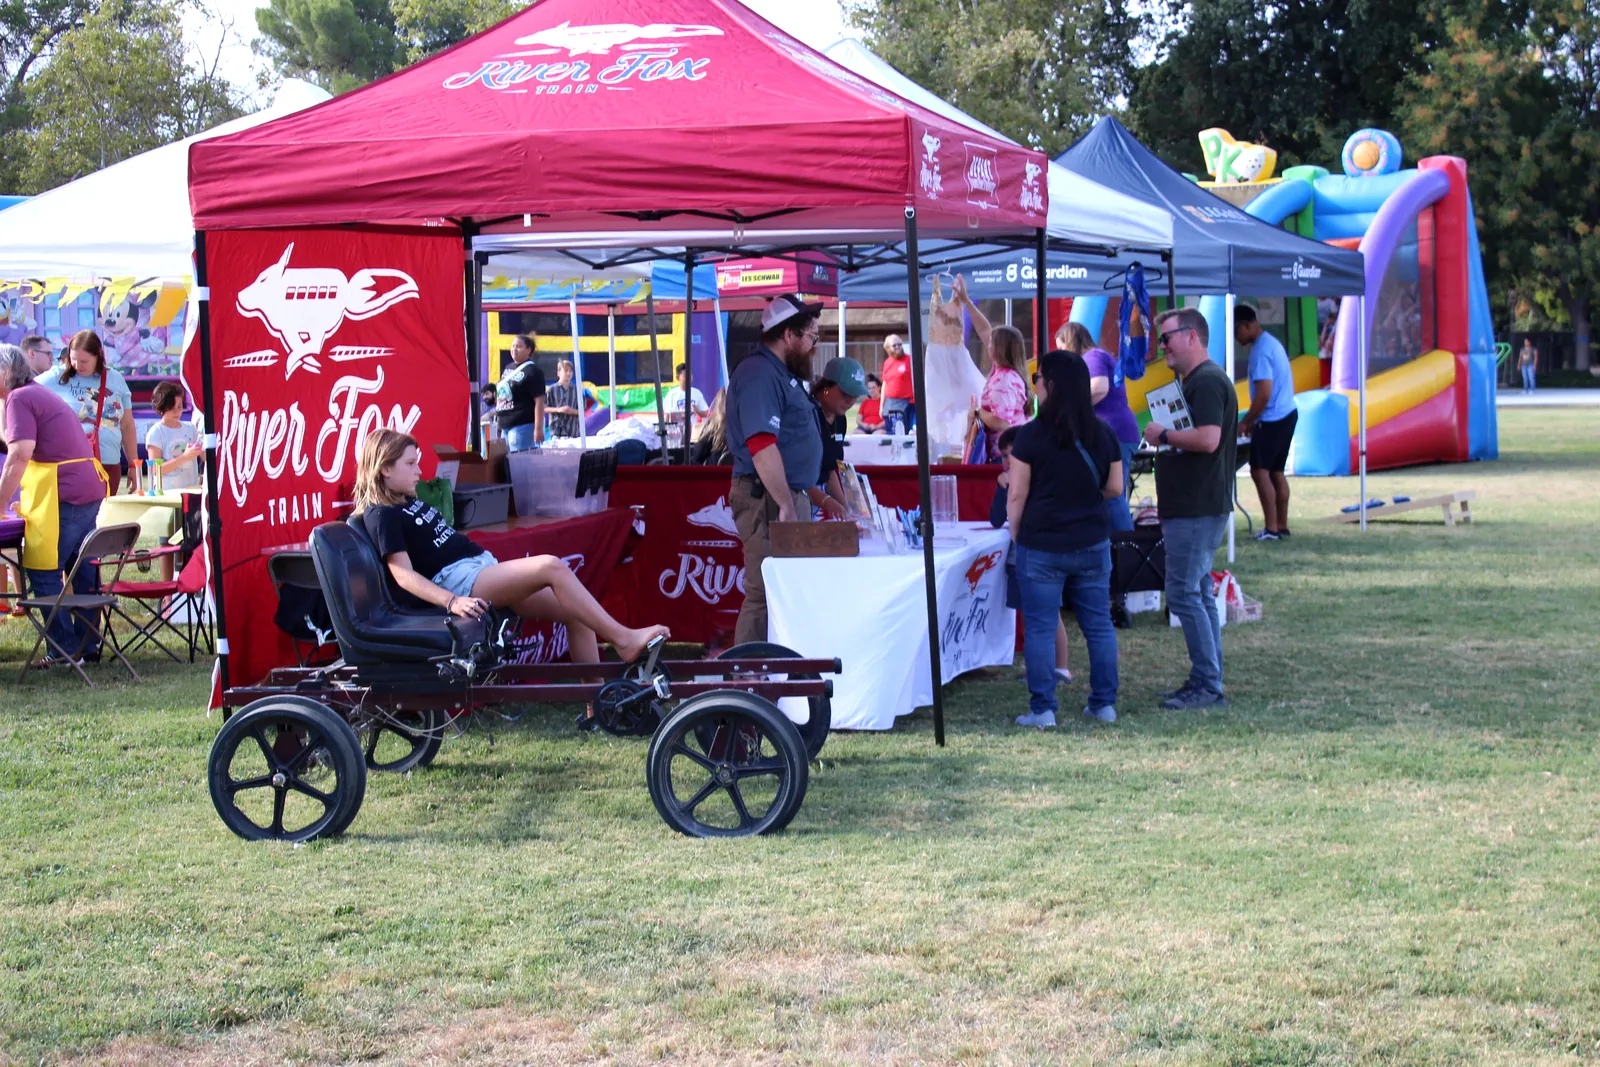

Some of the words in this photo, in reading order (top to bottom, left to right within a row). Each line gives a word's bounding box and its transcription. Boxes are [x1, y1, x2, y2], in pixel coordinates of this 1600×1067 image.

[443, 60, 590, 90] River
[597, 48, 711, 82] Fox
[536, 83, 599, 95] TRAIN
[753, 273, 780, 282] SCHWAB
[1021, 256, 1034, 264] The
[215, 389, 309, 508] River
[268, 491, 323, 526] TRAIN
[658, 552, 746, 604] Riv
